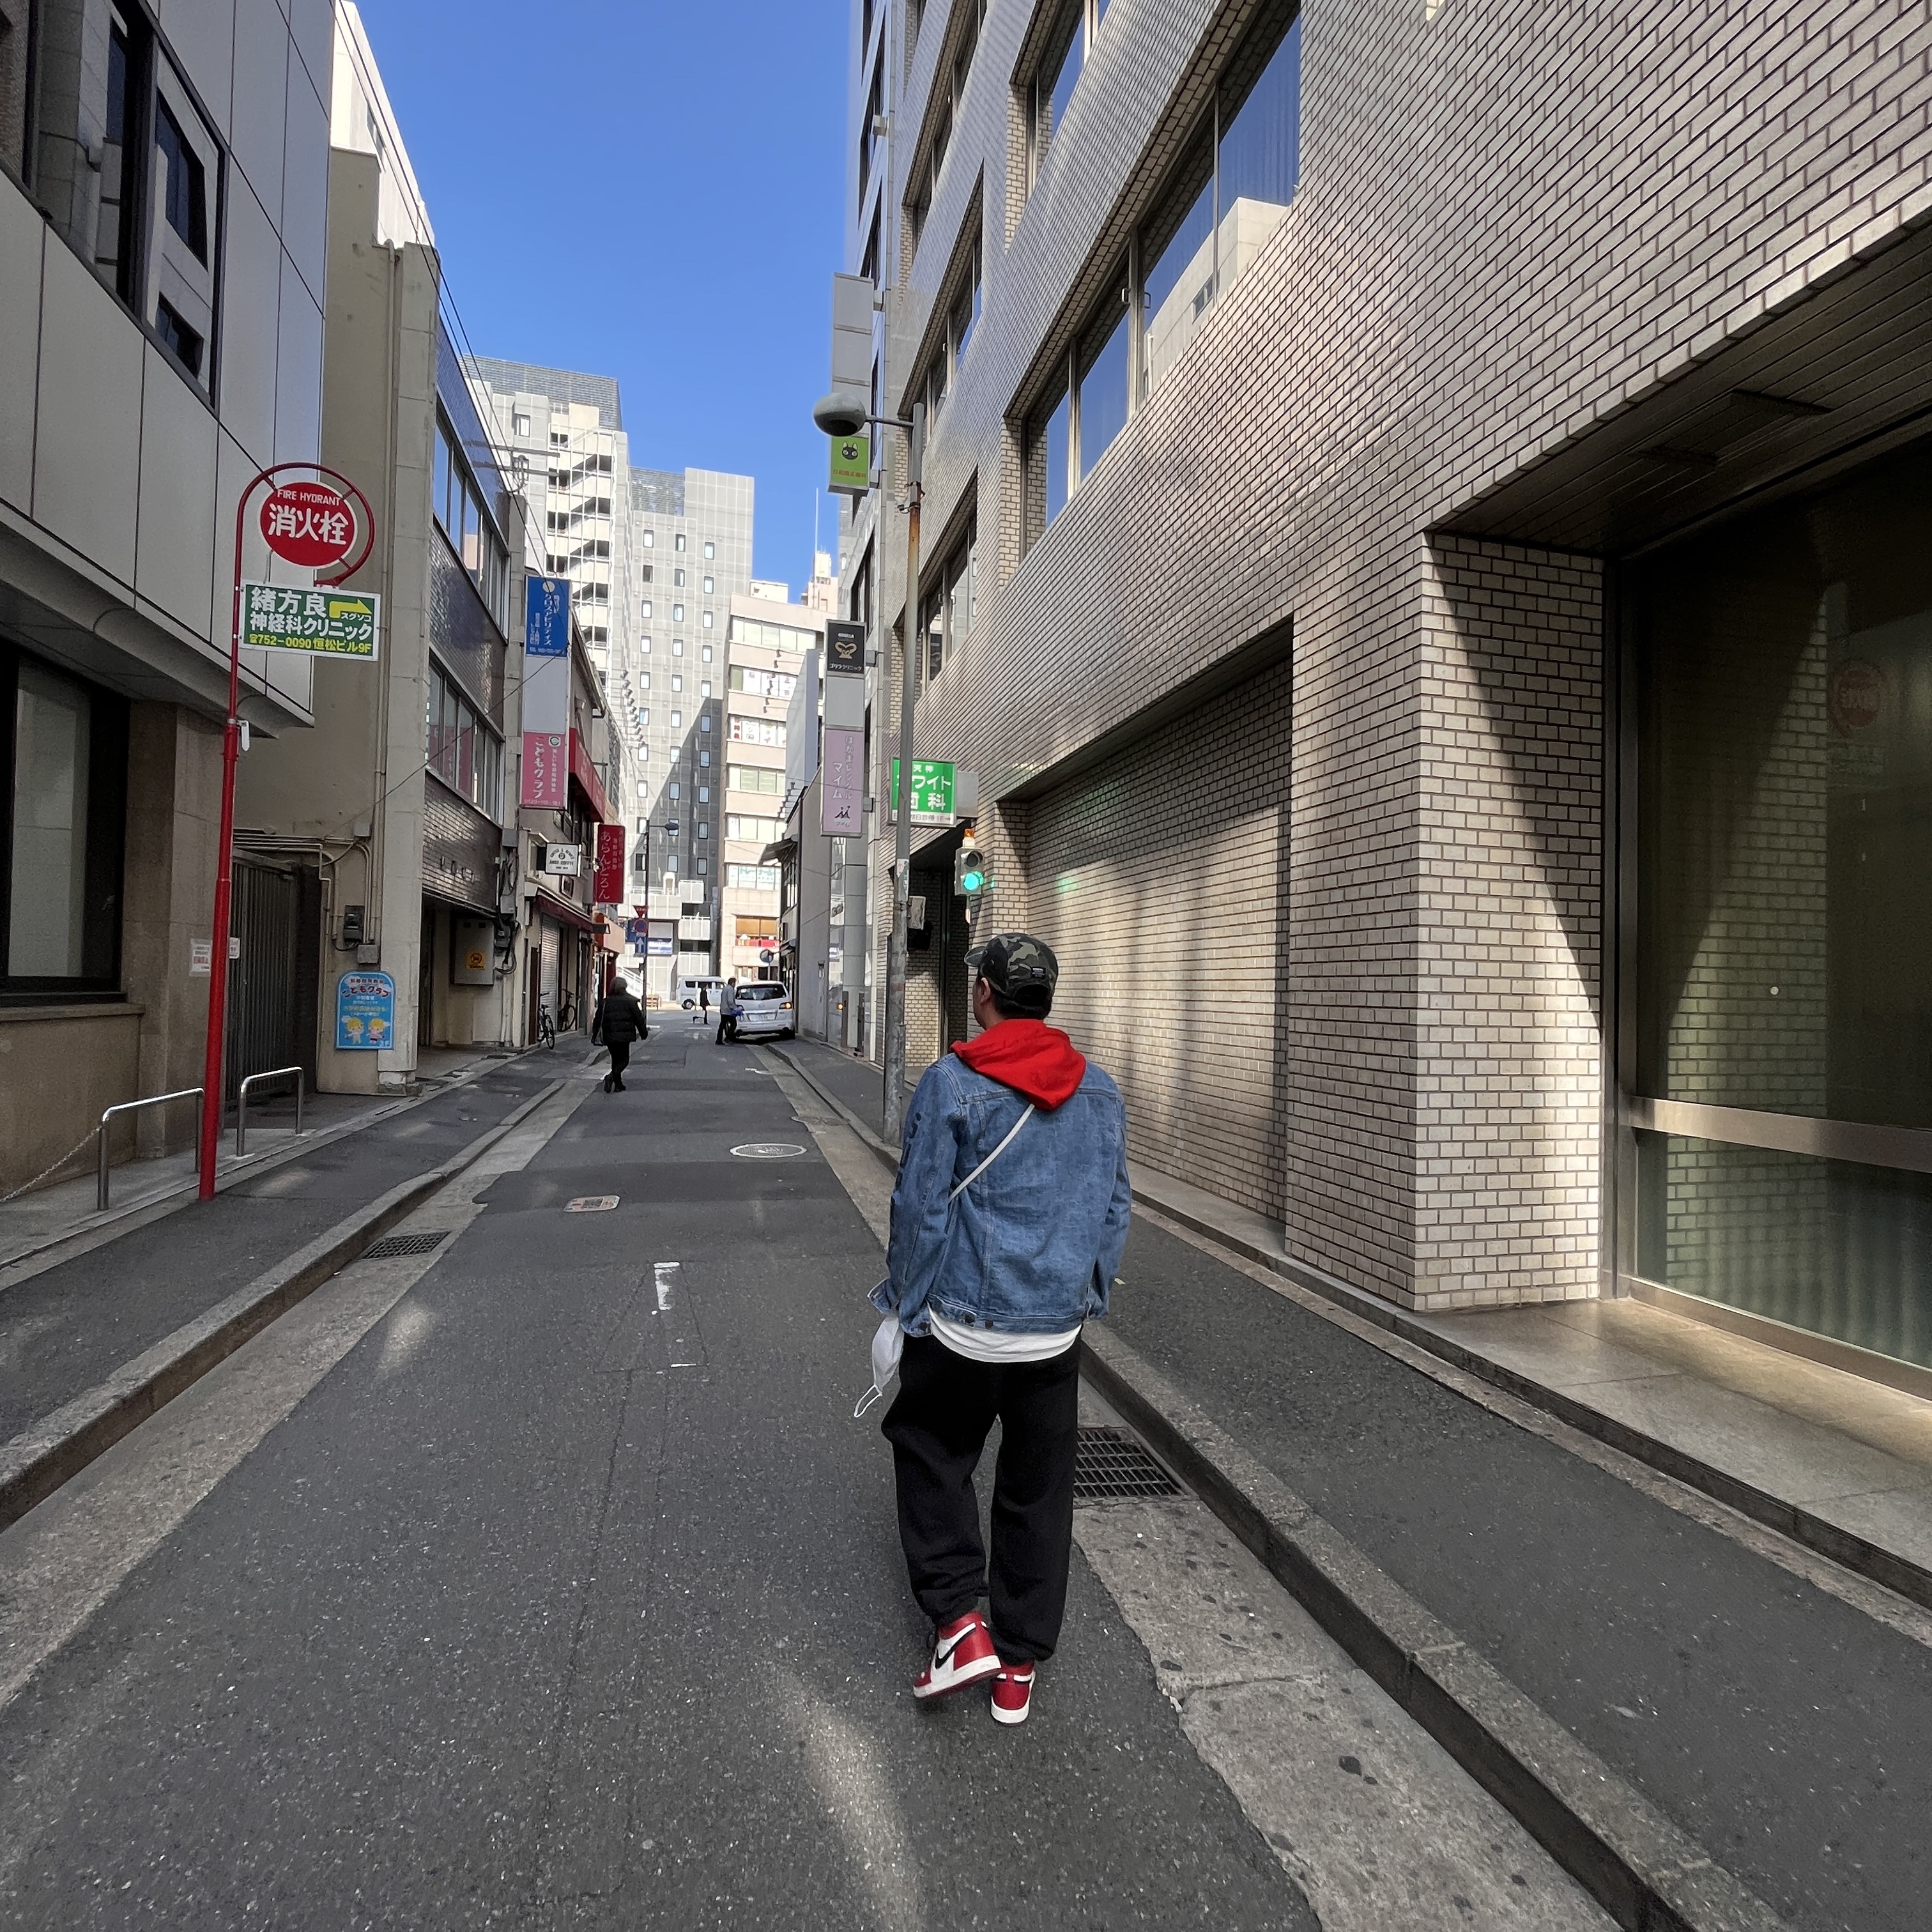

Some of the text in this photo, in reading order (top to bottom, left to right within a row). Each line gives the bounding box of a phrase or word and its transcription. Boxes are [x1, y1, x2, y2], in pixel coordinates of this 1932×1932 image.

[277, 489, 341, 506] FIRE HYDRANT
[268, 503, 349, 545] 消火栓
[250, 586, 326, 618] 緒方良
[341, 611, 372, 622] スグソコ
[250, 611, 372, 640] 神経科クリニック
[829, 663, 862, 671] ゴリラクリニック
[832, 762, 843, 799] マイム
[845, 736, 854, 799] はかまレンタル
[913, 764, 934, 774] 天神
[896, 774, 951, 791] ワイト
[598, 831, 611, 900] あらんどろん
